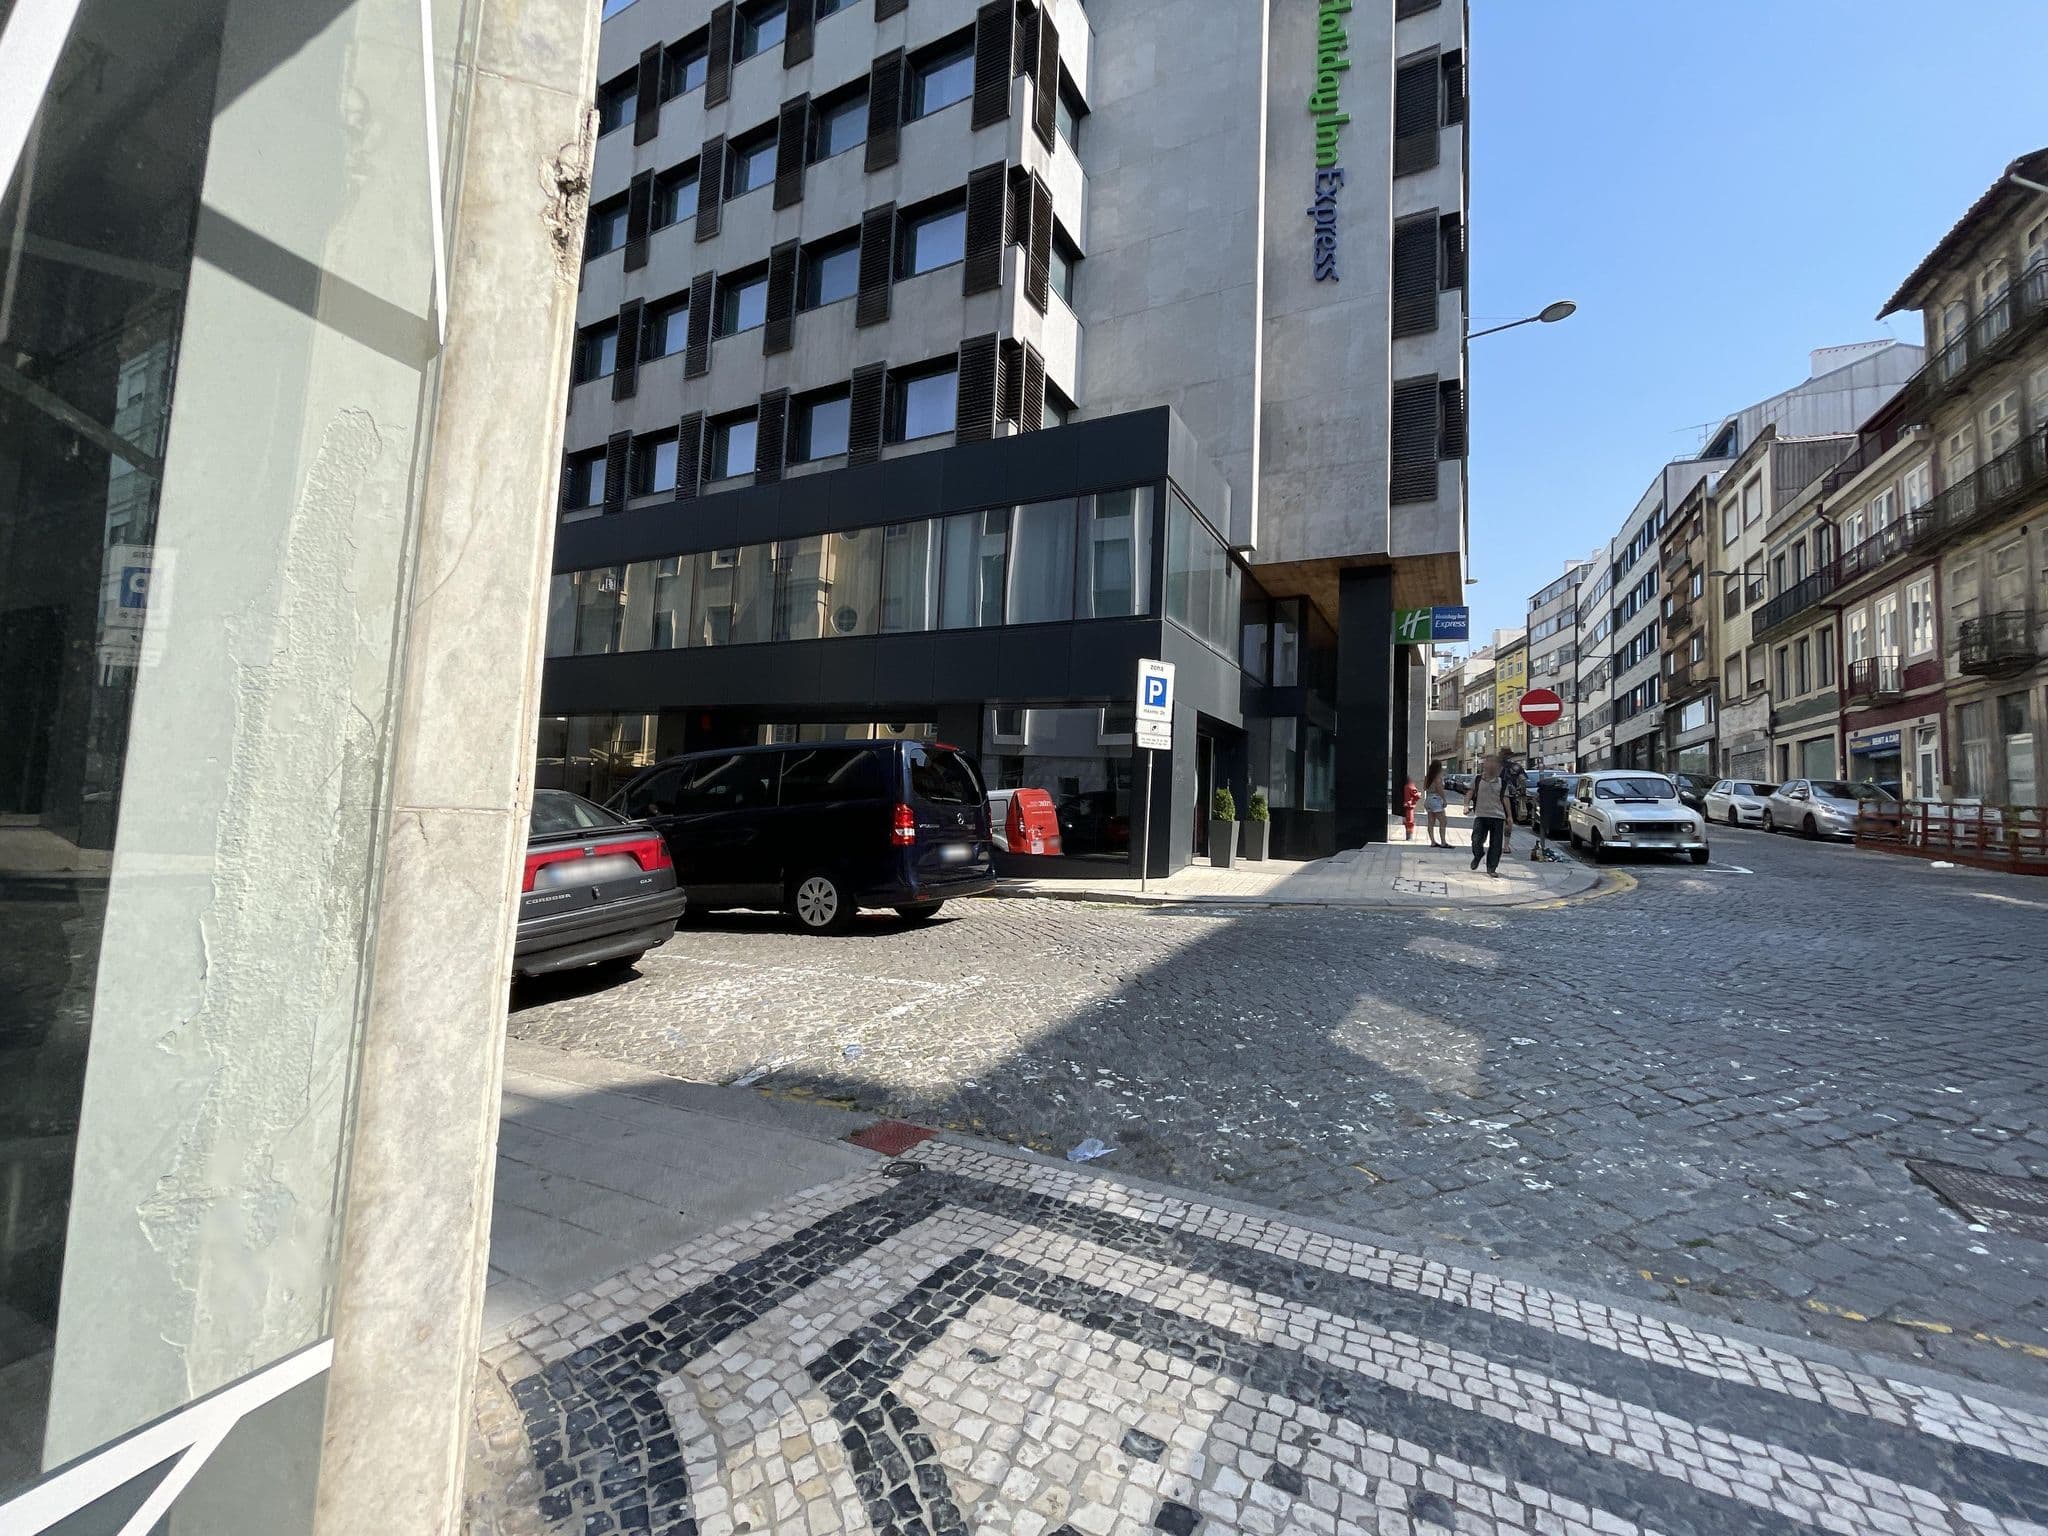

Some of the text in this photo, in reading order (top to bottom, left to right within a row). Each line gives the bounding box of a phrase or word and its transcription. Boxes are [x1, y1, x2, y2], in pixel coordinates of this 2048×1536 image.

[1315, 113, 1351, 168] Inn
[1306, 168, 1345, 283] Express
[1435, 620, 1466, 628] Express
[1148, 679, 1163, 704] P
[525, 893, 572, 905] CORDOBA
